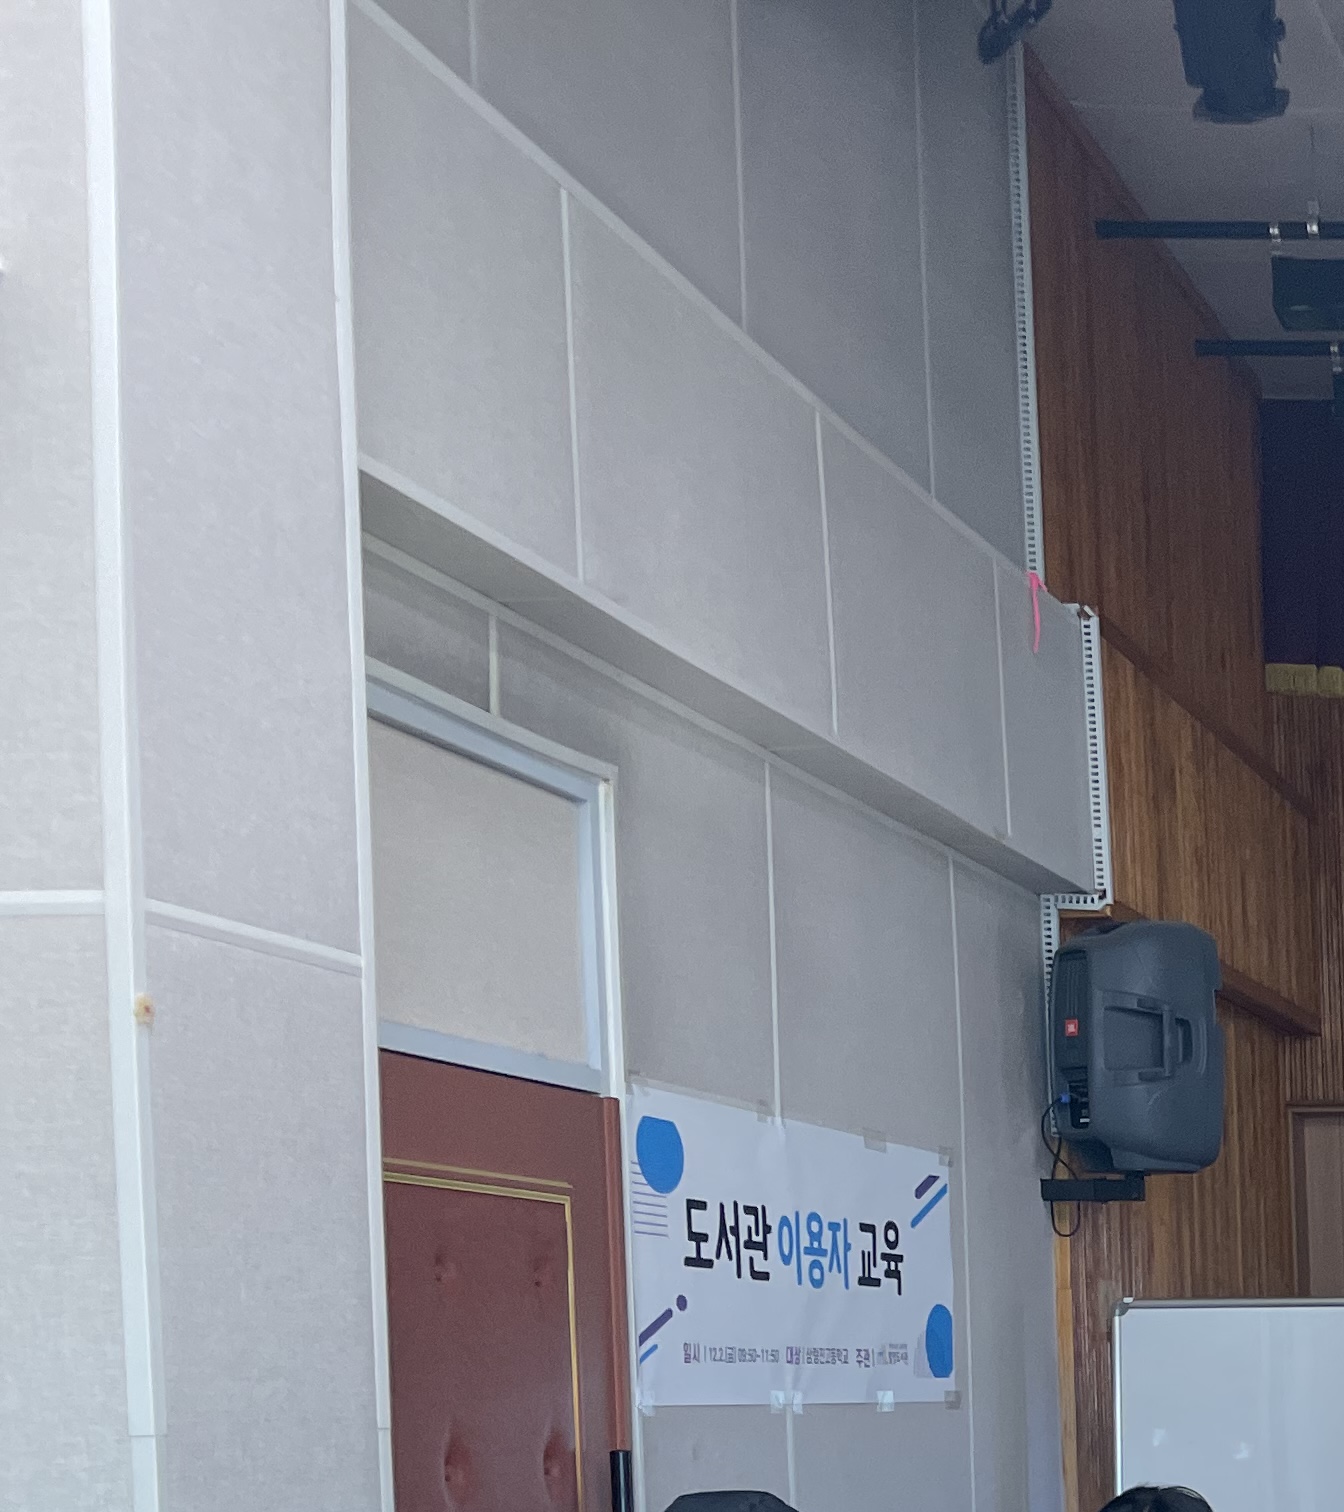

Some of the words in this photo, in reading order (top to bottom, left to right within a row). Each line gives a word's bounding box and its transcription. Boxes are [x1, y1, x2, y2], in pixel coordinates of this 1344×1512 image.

[683, 1197, 772, 1282] 도서관
[777, 1210, 852, 1291] 이용자
[857, 1219, 905, 1297] 교육
[683, 1341, 701, 1364] 일시
[785, 1345, 801, 1365] 대상
[855, 1348, 871, 1369] 주관
